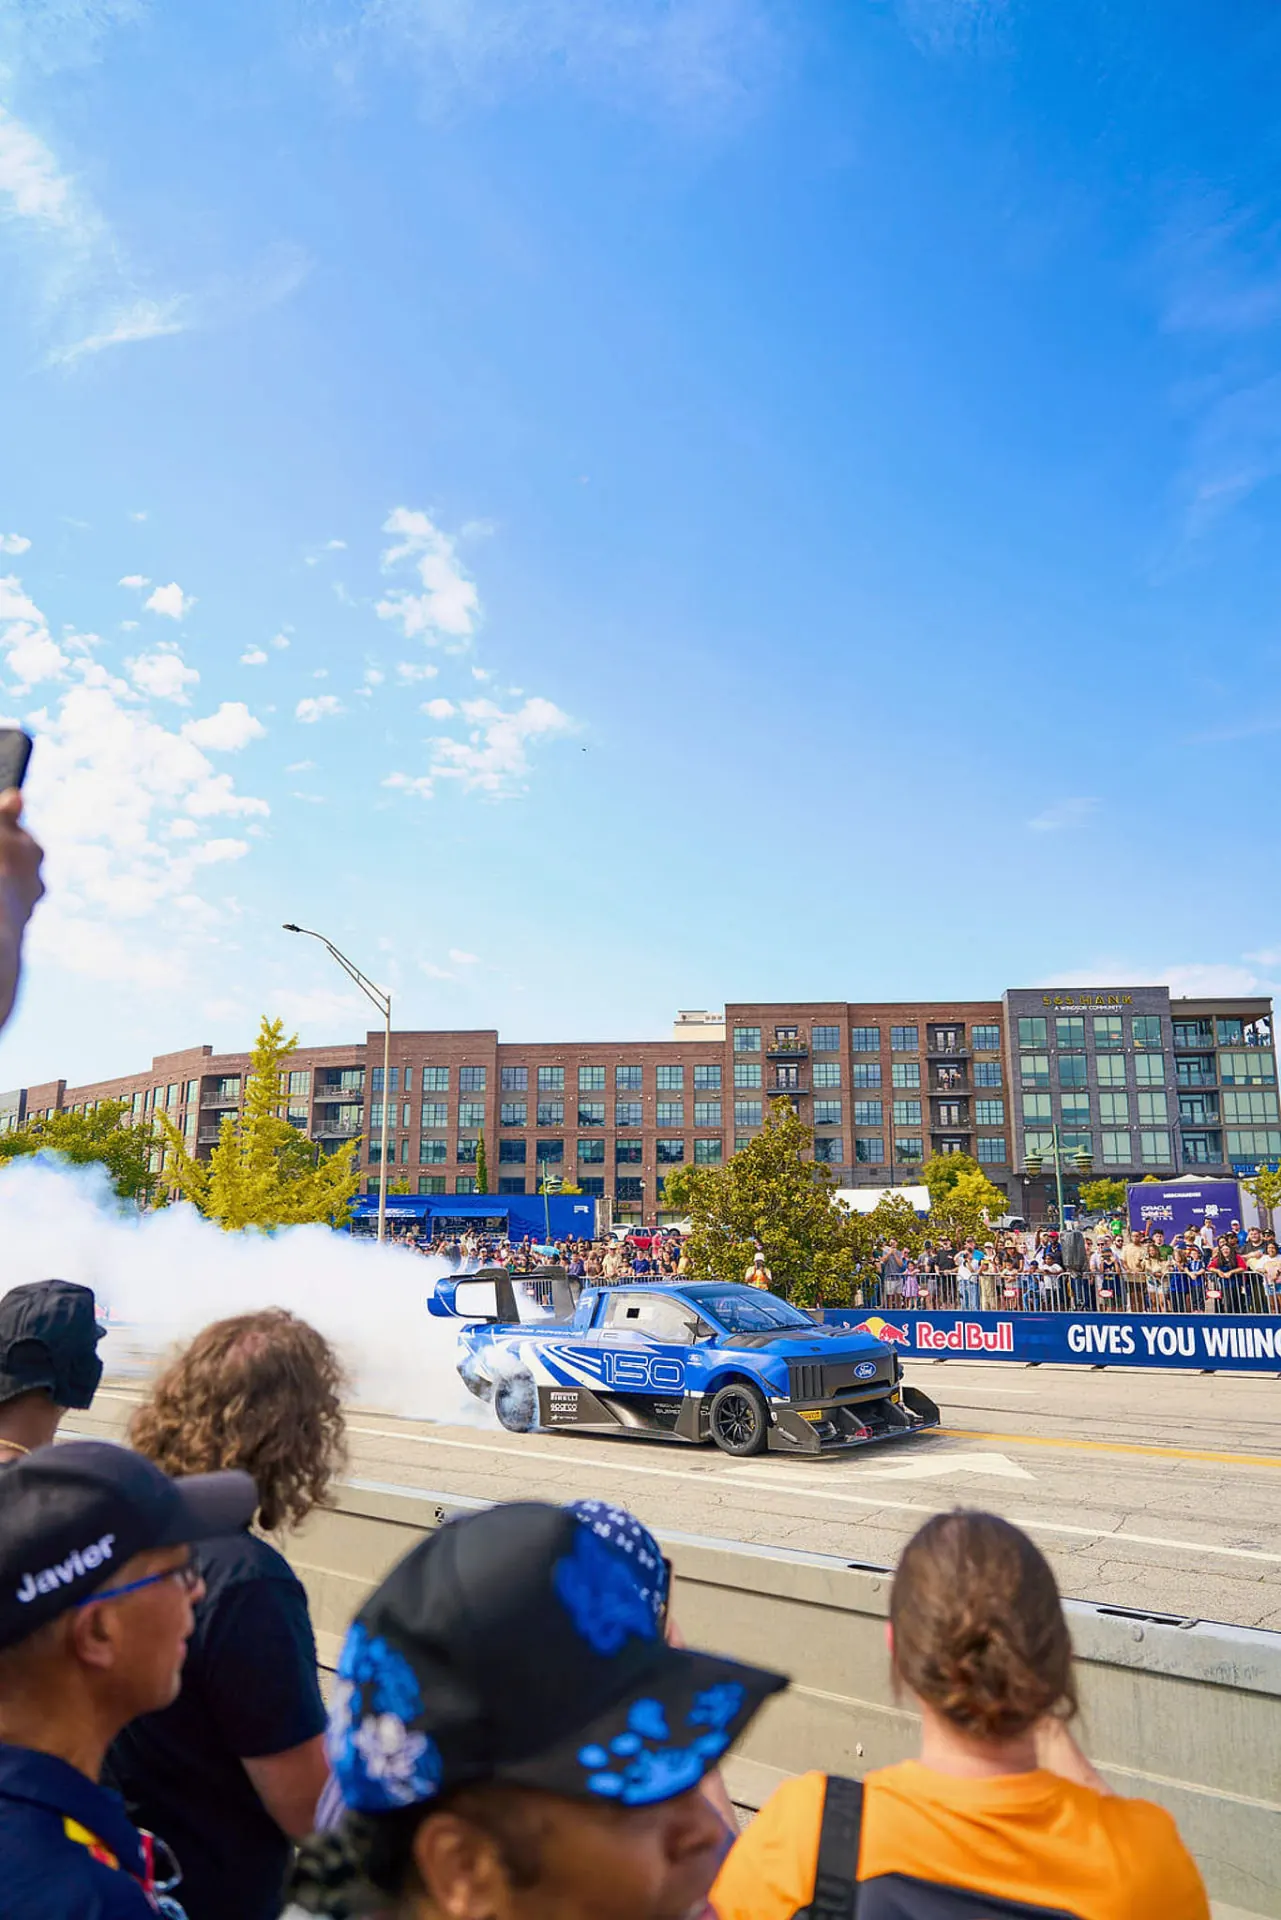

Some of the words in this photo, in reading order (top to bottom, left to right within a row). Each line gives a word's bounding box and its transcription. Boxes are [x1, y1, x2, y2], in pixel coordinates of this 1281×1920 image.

[1079, 995, 1133, 1005] HANK
[1068, 1324, 1136, 1355] GIVES
[1141, 1326, 1196, 1357] YOU
[602, 1353, 685, 1390] 150
[16, 1533, 116, 1603] Javier
